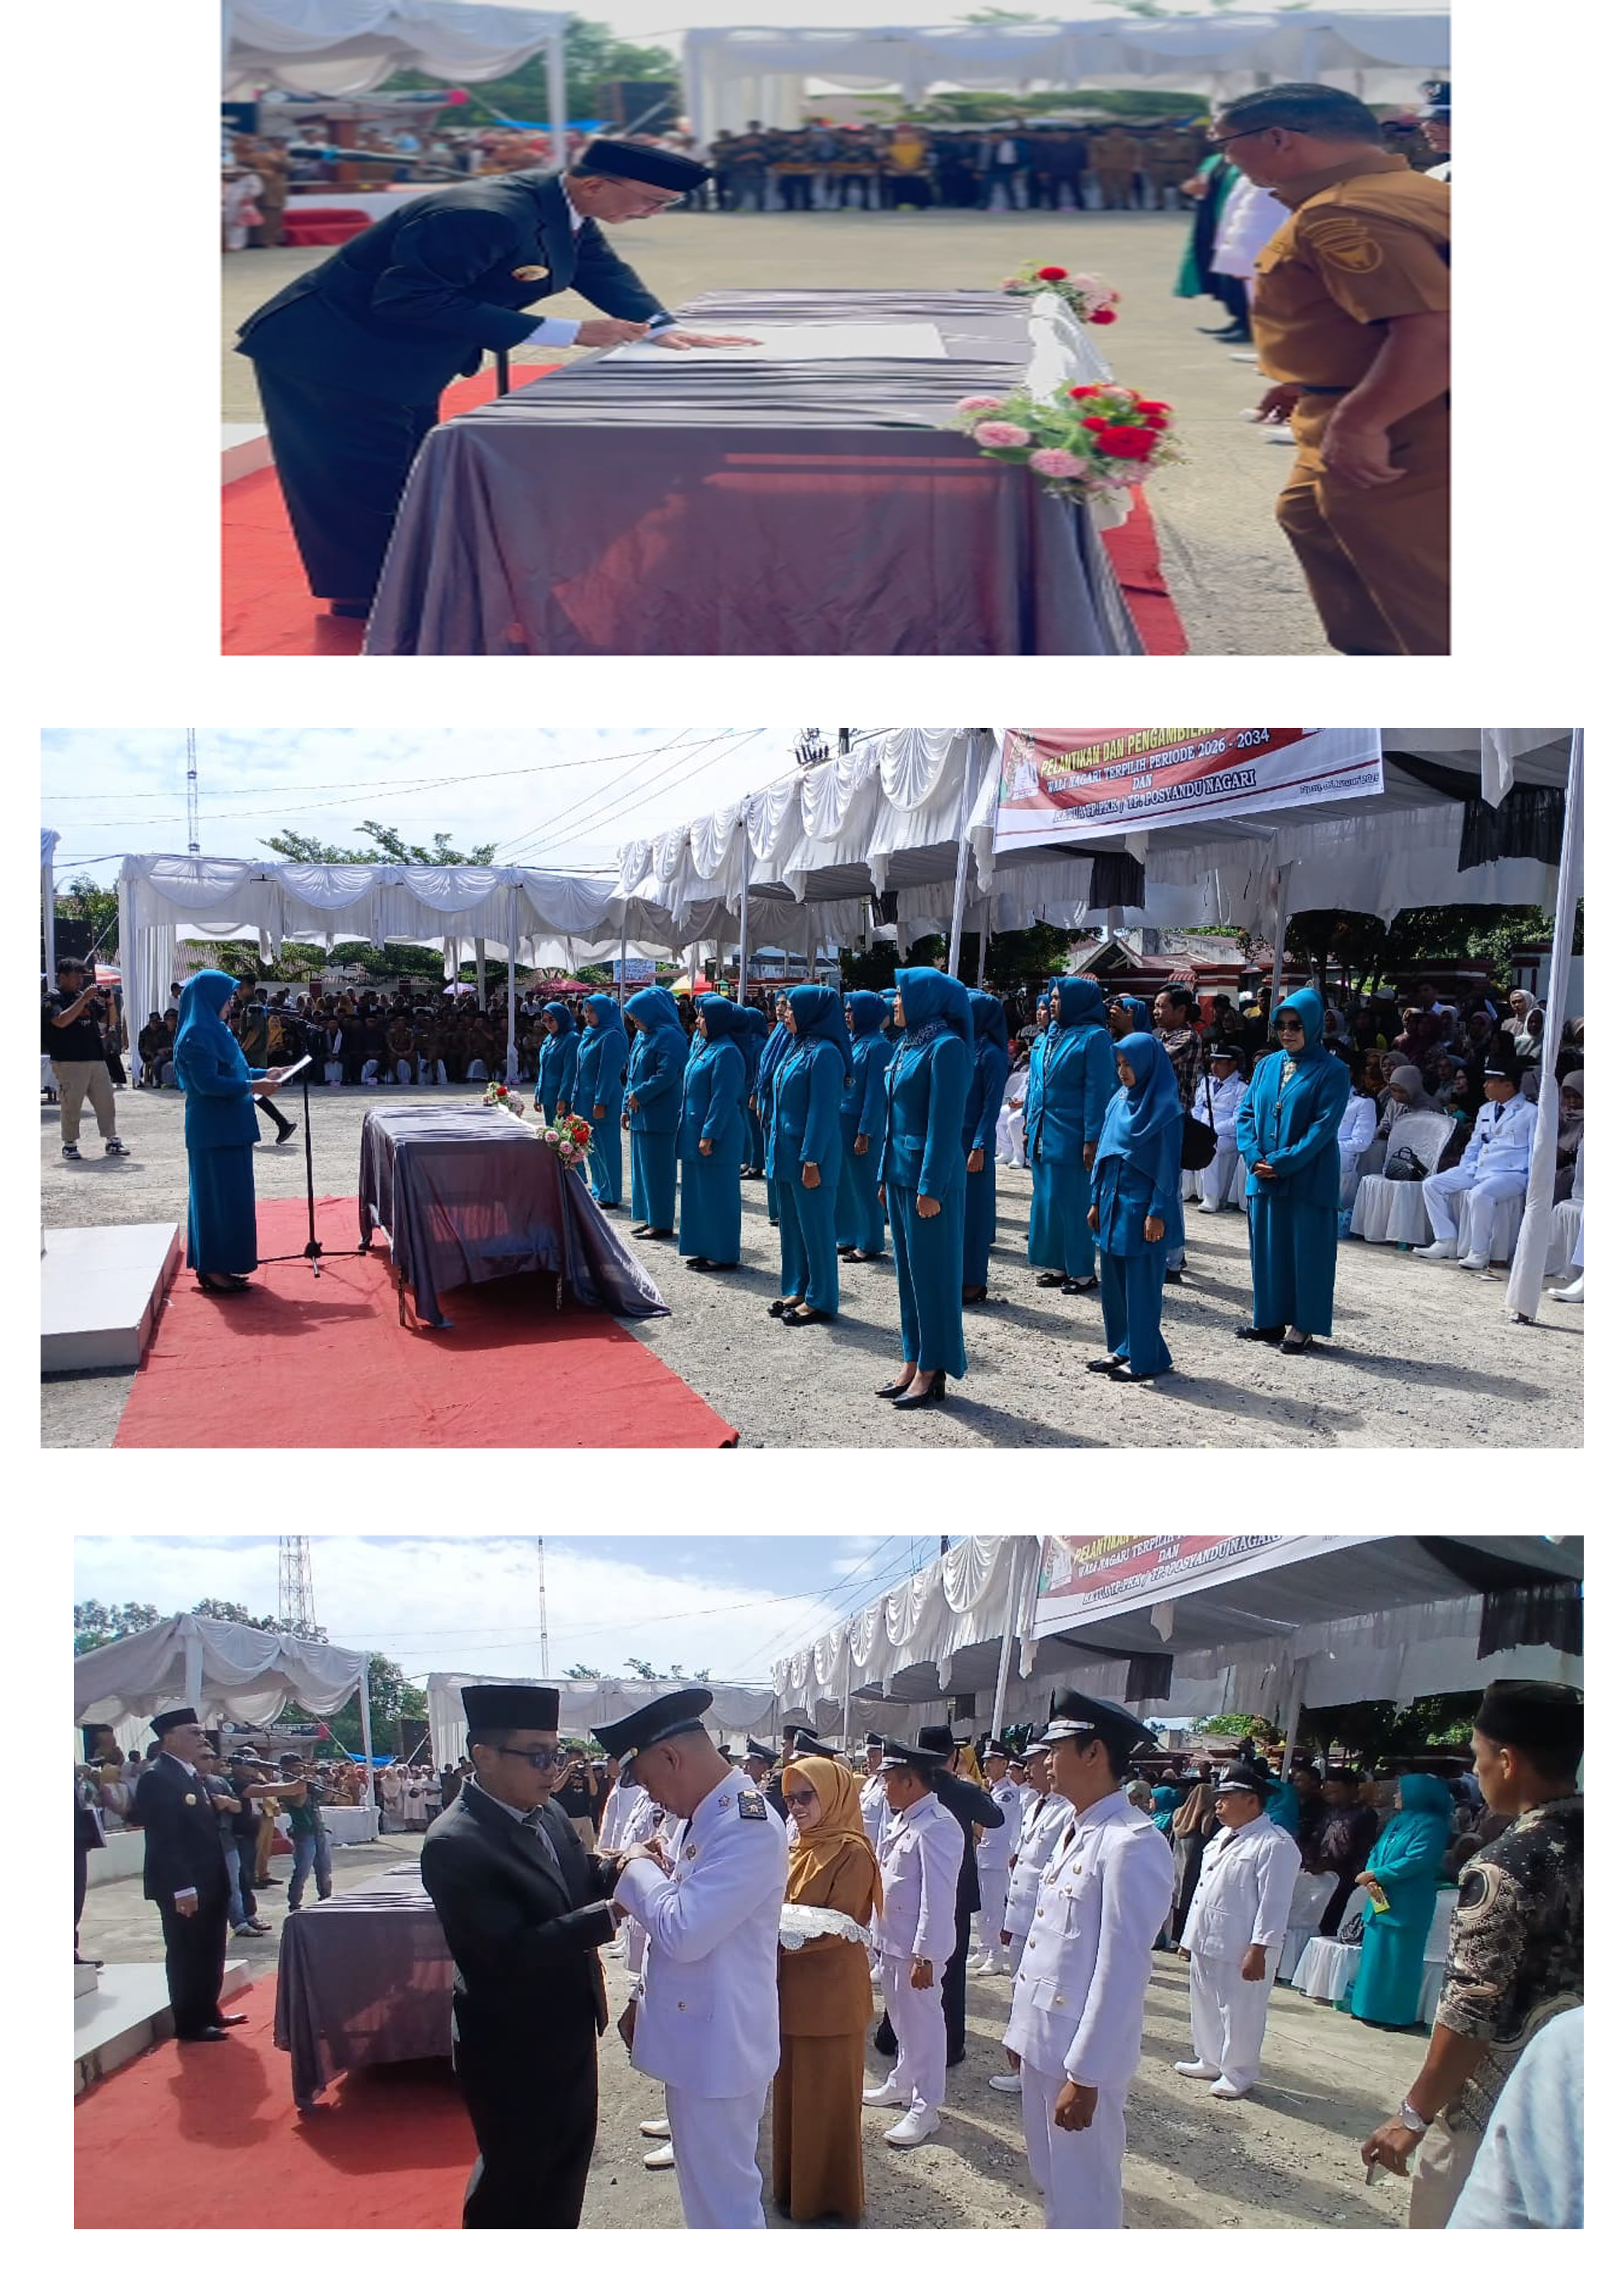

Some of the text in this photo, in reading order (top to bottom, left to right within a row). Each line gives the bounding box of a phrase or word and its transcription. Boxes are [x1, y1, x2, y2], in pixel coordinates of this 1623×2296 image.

[1041, 745, 1100, 777] PELANTIKAN
[1103, 738, 1124, 761] DAN
[1069, 770, 1102, 788] NAGARI
[1104, 757, 1146, 780] TERPILIH
[1149, 745, 1194, 768] PERIODE
[1198, 738, 1226, 757] 2026
[1236, 728, 1270, 748] 2034
[1132, 774, 1152, 790] DAN
[1144, 780, 1203, 806] POSYANDU
[1204, 770, 1256, 795] NAGARI
[1098, 1548, 1130, 1570] NAGARI
[1158, 1543, 1180, 1563] DAN
[1168, 1539, 1228, 1576] POSYANDU
